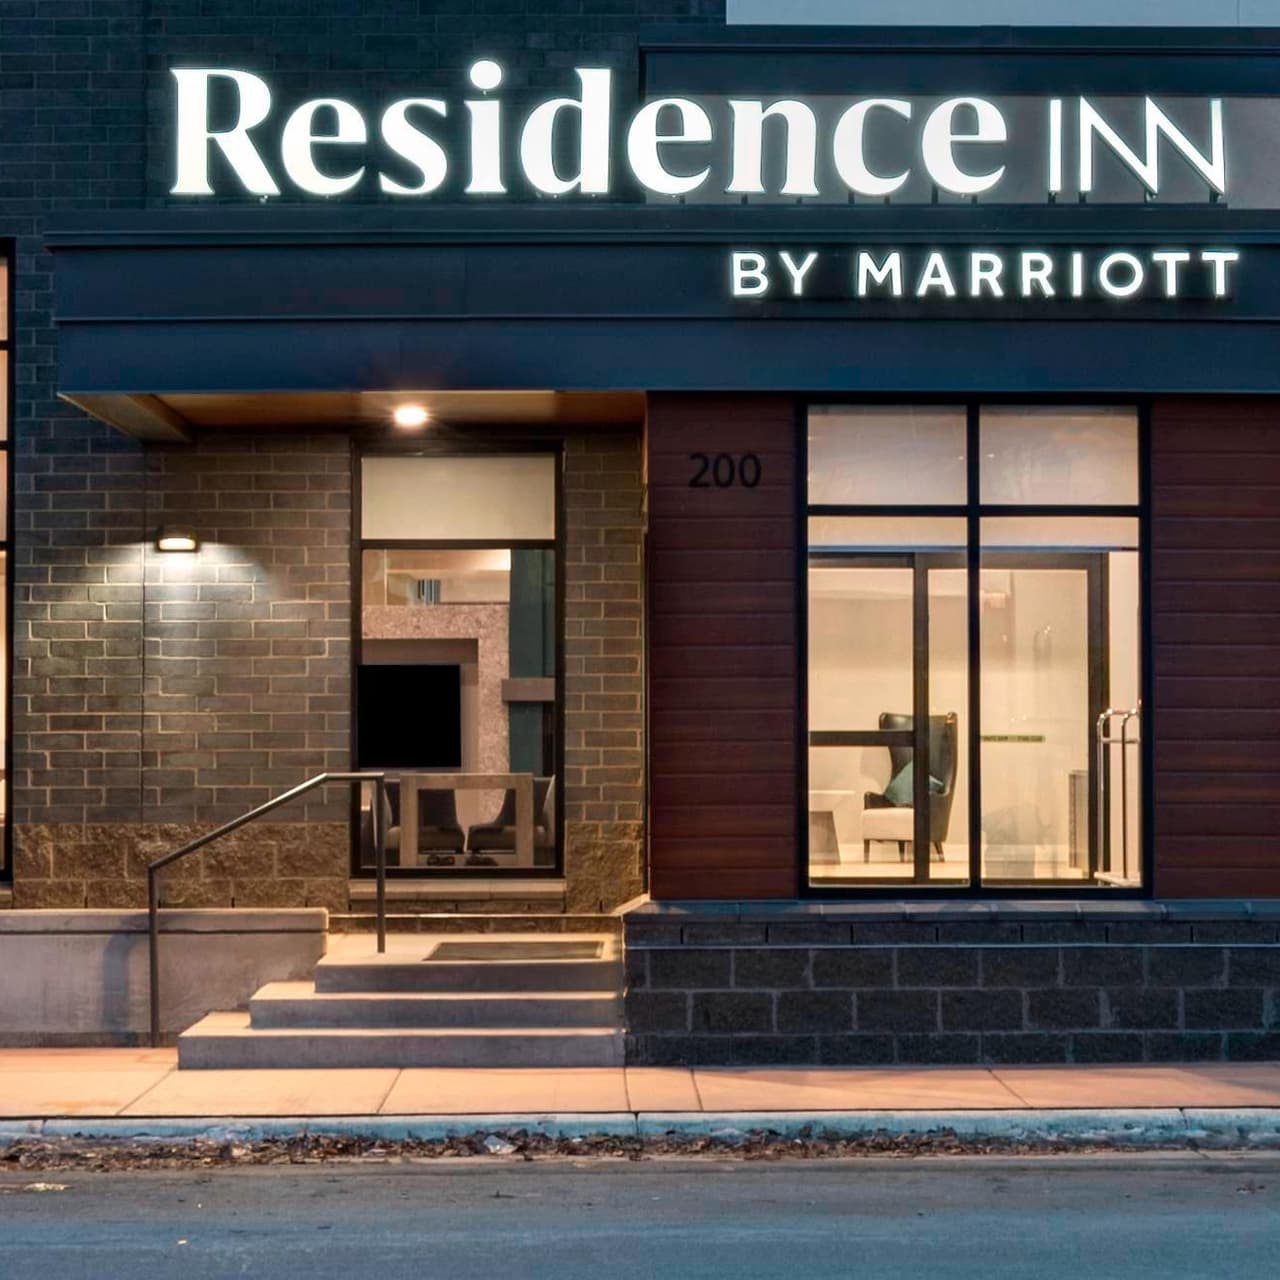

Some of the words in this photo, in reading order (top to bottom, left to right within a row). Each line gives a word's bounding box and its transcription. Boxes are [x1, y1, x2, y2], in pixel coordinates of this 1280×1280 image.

[169, 59, 1008, 196] Residence
[1048, 95, 1226, 195] INN
[731, 251, 818, 296] BY
[857, 251, 1240, 297] MARRIOTT
[688, 452, 762, 488] 200
